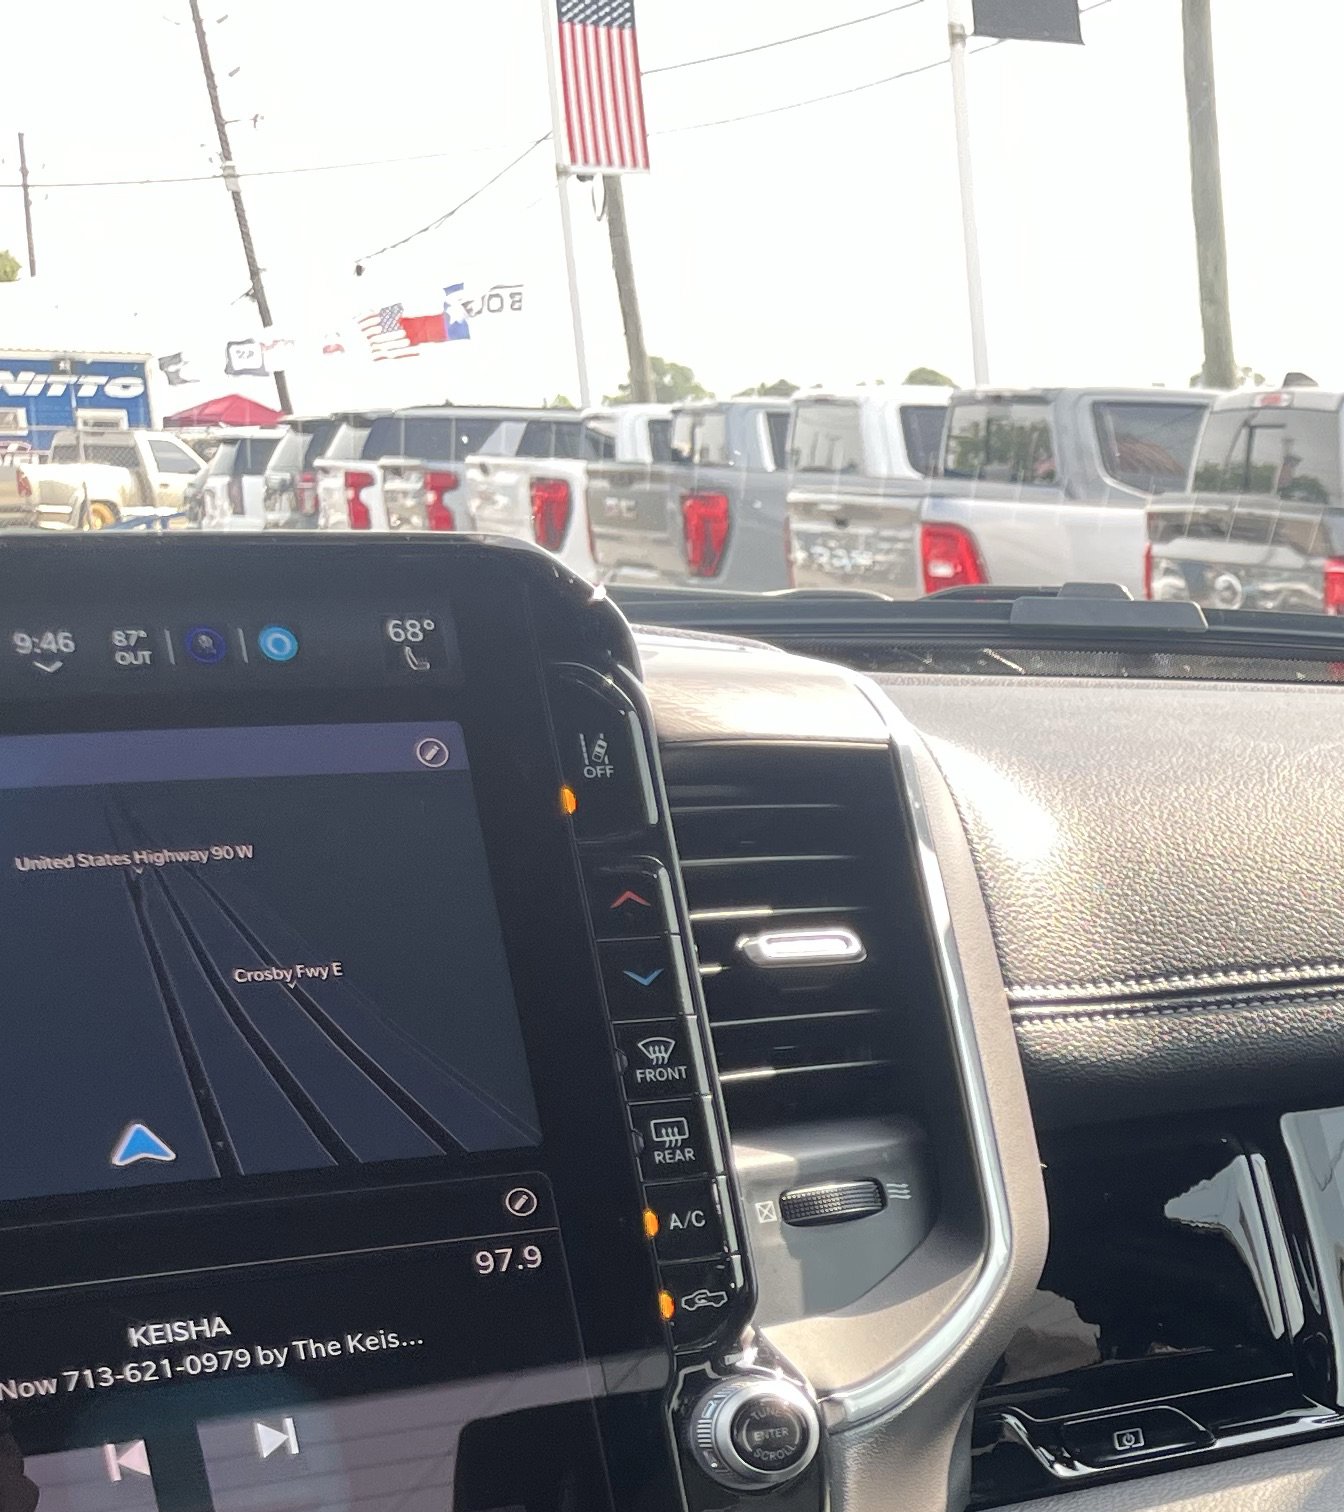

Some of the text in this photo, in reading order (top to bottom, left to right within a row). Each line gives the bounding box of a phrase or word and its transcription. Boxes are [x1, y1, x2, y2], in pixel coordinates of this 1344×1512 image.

[13, 631, 75, 654] 9:46
[115, 651, 153, 666] OUT
[583, 765, 615, 779] OFF
[15, 844, 254, 872] United States Highway 90 W
[233, 962, 343, 983] Crosby Fwy E
[636, 1066, 688, 1084] FRONT
[653, 1148, 696, 1164] REAR
[669, 1210, 706, 1231] A/C
[474, 1244, 543, 1275] 97.9
[128, 1315, 231, 1348] KEISHA
[0, 1376, 58, 1402] Now
[63, 1347, 252, 1393] 713-621-0979
[255, 1343, 289, 1371] by
[292, 1335, 343, 1362] The
[751, 1407, 788, 1421] TUNE
[753, 1427, 789, 1442] ENTER
[753, 1444, 797, 1462] SCROLL
